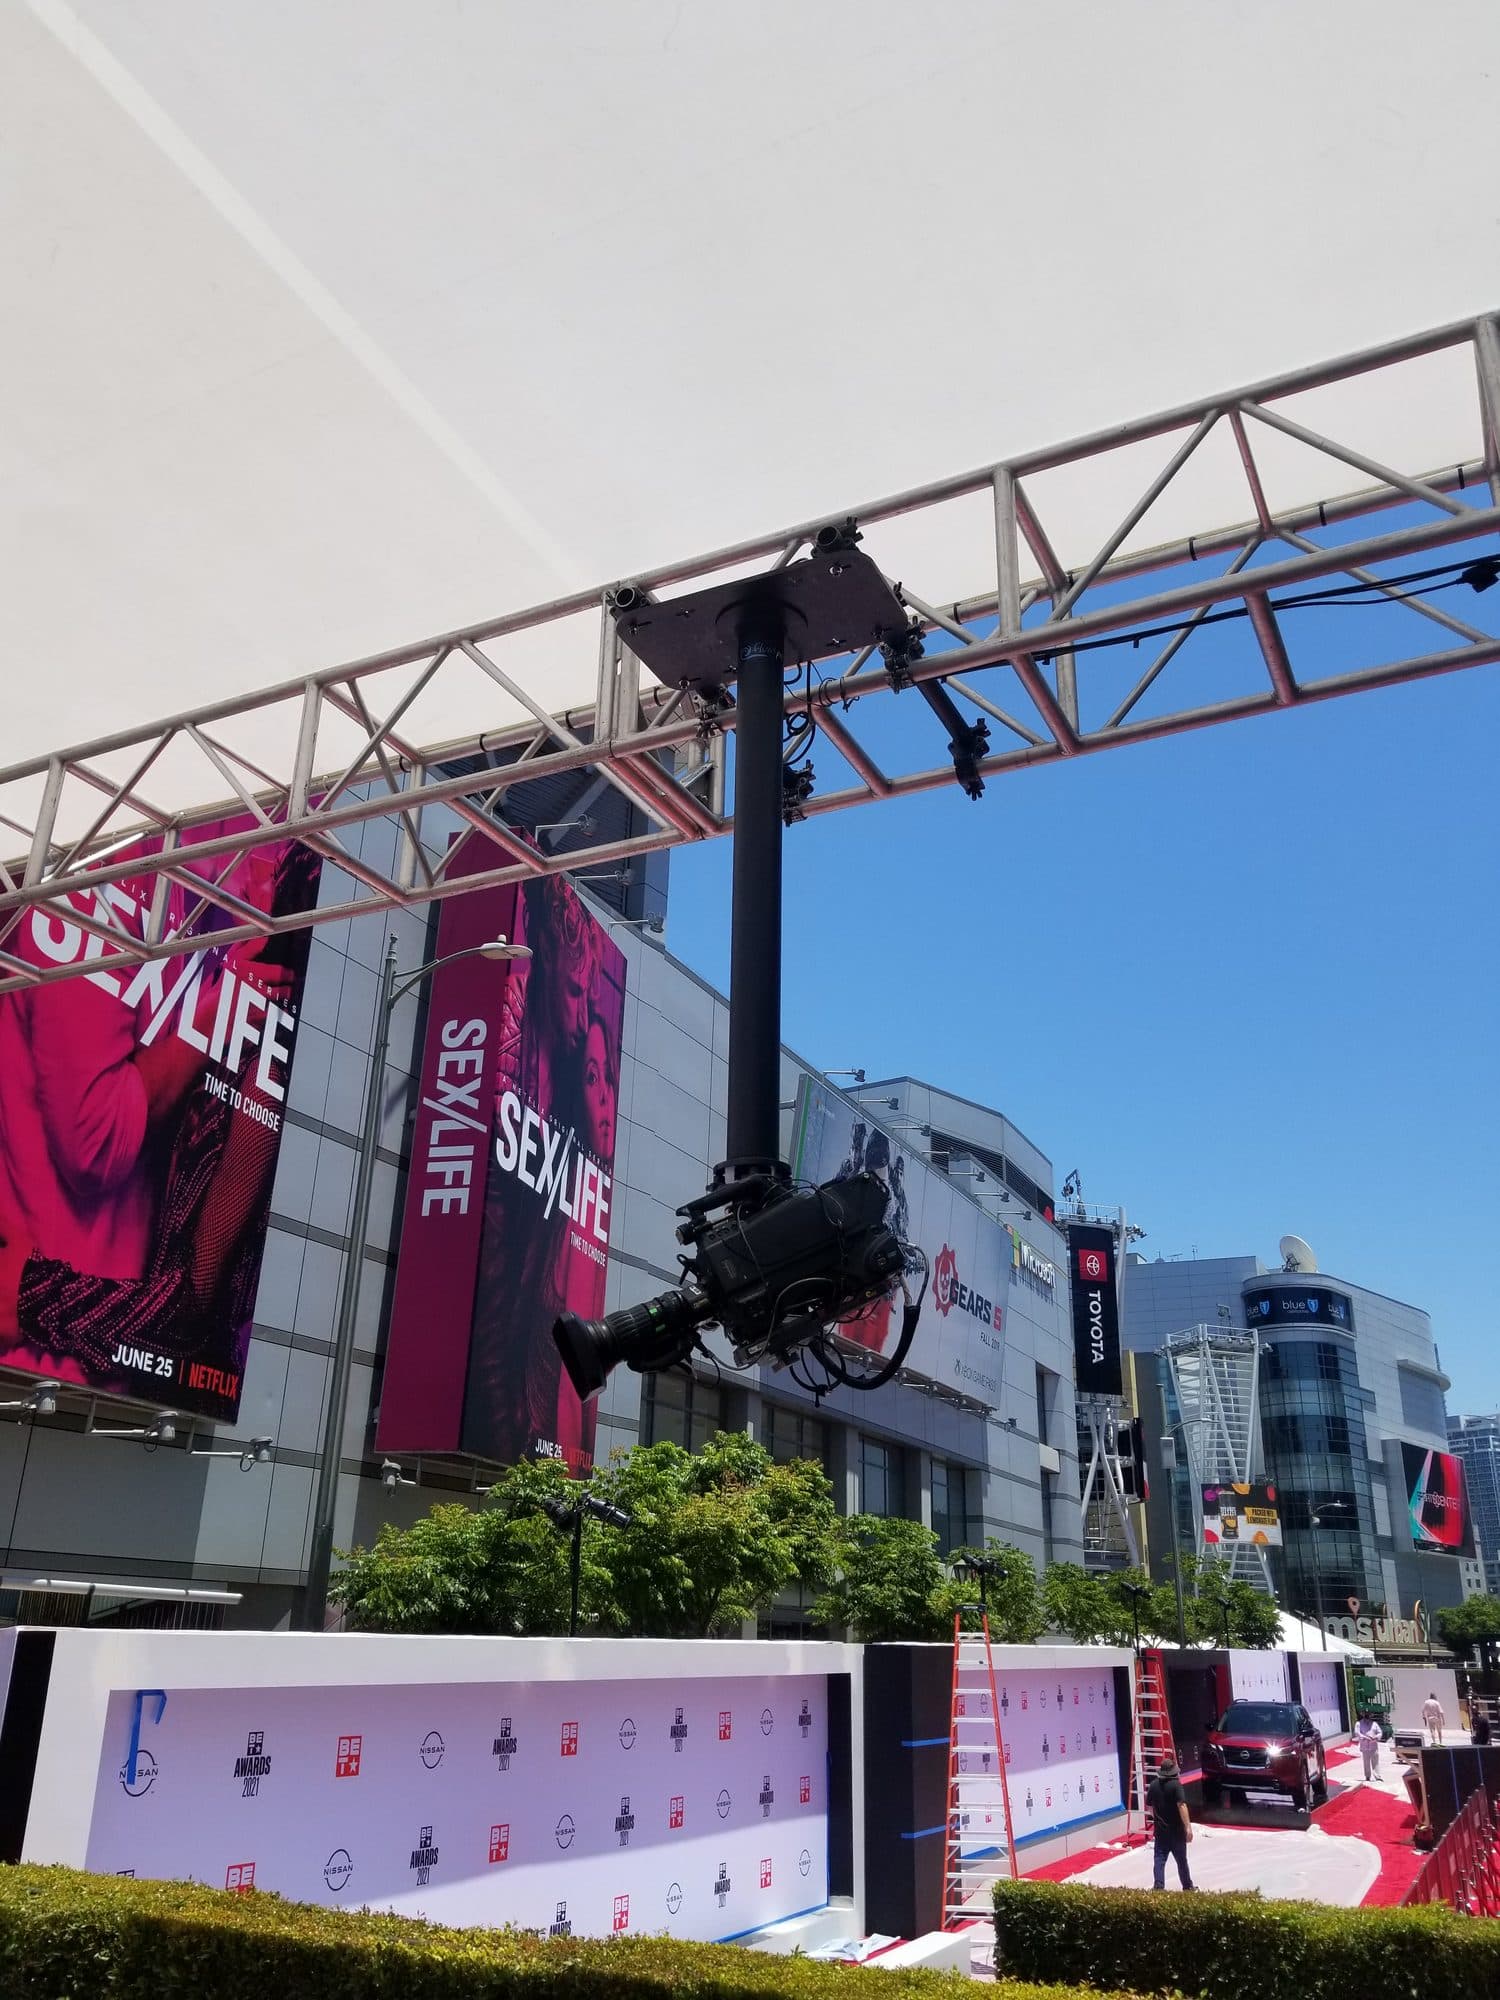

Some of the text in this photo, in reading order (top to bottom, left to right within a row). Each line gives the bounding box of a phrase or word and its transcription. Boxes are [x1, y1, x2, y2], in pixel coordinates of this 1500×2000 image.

[205, 1072, 281, 1133] TIME TO CHOOSE
[421, 1018, 488, 1217] SEX/LIFE
[496, 1090, 611, 1244] SEX/LIFE
[949, 1277, 1002, 1331] GEARS 5
[1282, 1300, 1306, 1310] blue
[1089, 1289, 1105, 1364] TOYOTA
[111, 1344, 174, 1378] JUNE 25
[188, 1362, 239, 1401] NETFLIX
[535, 1438, 563, 1458] JUNE 25
[619, 1730, 637, 1738] NISSAN
[419, 1746, 446, 1754] NISSAN
[492, 1737, 517, 1755] AWARDS
[119, 1768, 159, 1779] NSAN
[234, 1755, 271, 1778] AWARDS
[242, 1777, 260, 1798] 2021
[555, 1828, 576, 1836] NISSAN
[410, 1847, 439, 1869] AWARDS
[323, 1864, 353, 1876] NISSAN
[416, 1867, 430, 1886] 2021
